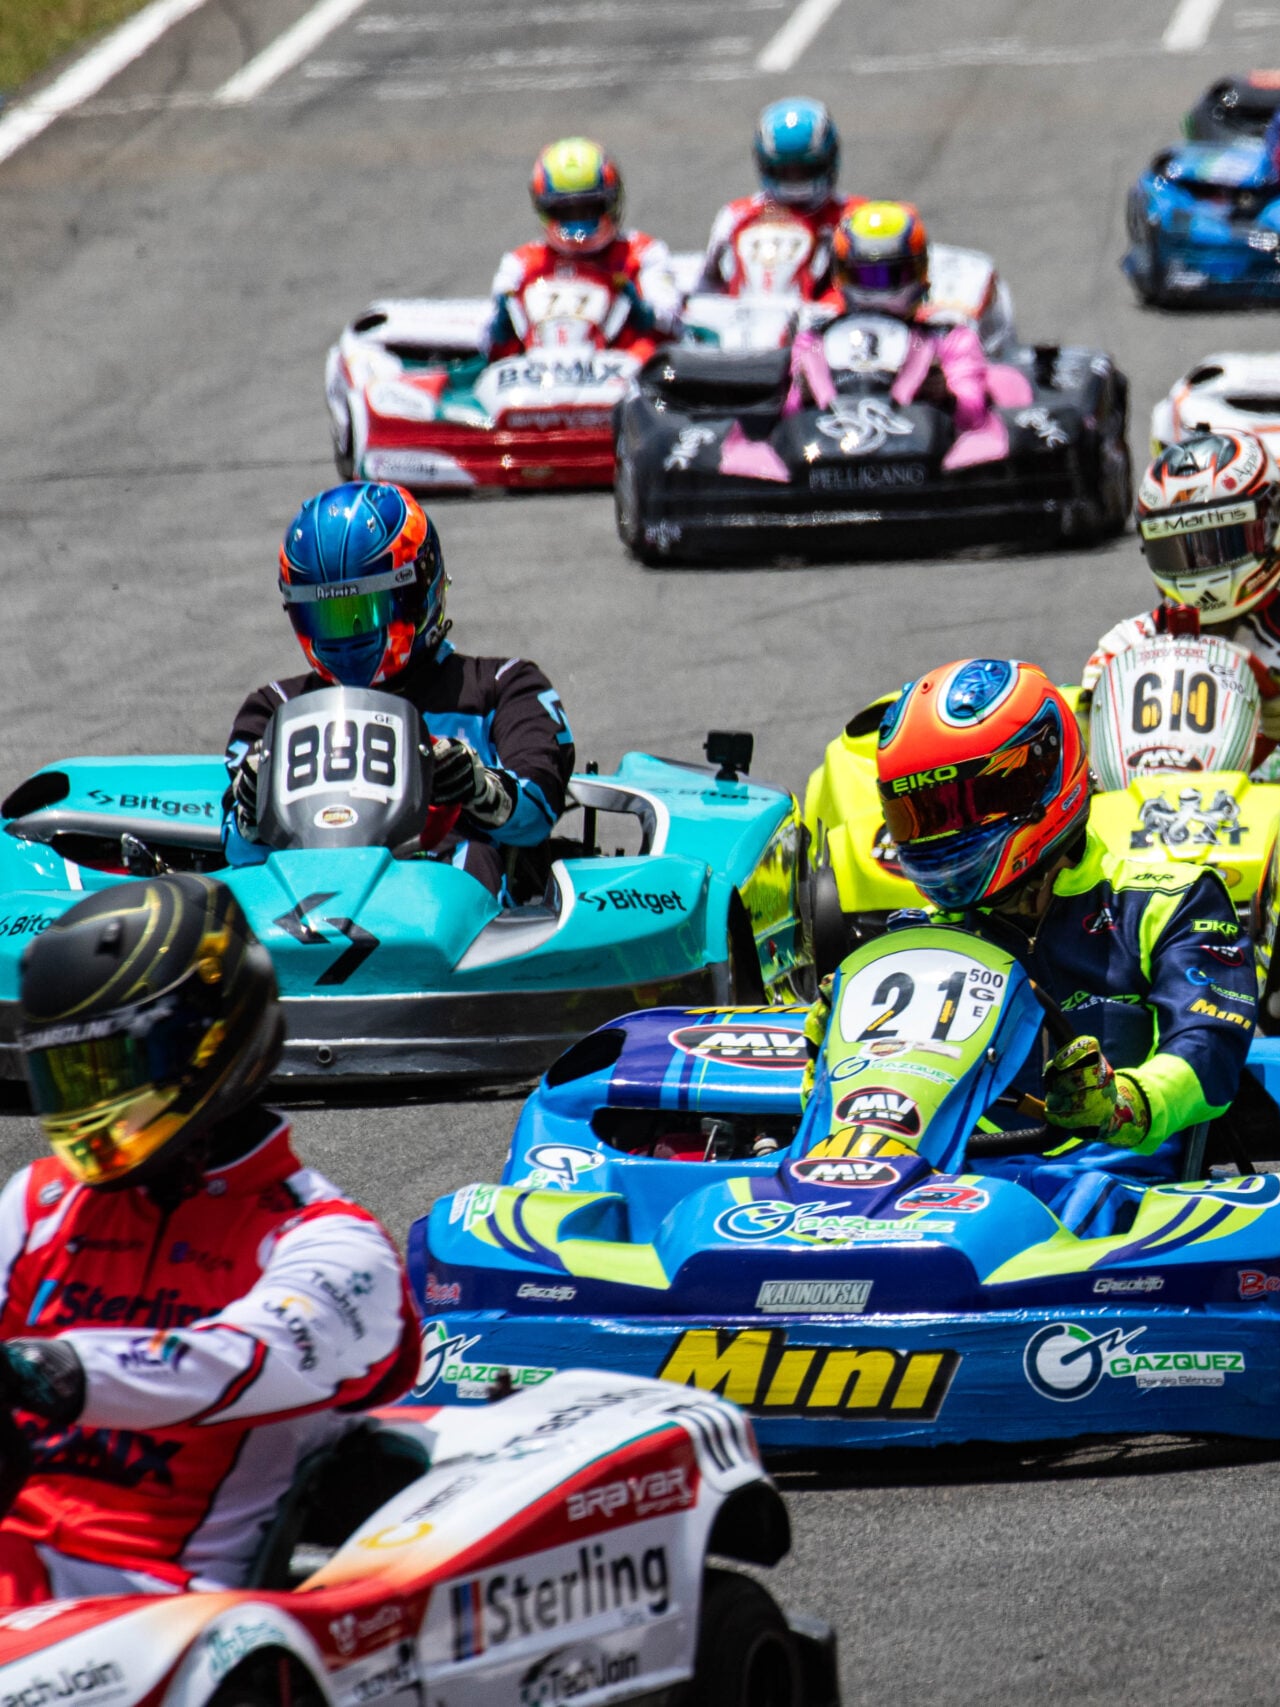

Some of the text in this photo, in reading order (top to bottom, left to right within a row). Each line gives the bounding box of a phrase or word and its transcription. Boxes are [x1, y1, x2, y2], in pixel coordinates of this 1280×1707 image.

[1165, 508, 1247, 530] Martins
[1132, 669, 1218, 735] 610
[374, 714, 394, 724] GE
[287, 719, 396, 792] 888
[892, 765, 958, 794] EIKO
[119, 794, 215, 818] Bitget
[605, 888, 687, 914] Bitget
[968, 967, 1004, 989] 500
[969, 986, 995, 1002] G
[856, 970, 968, 1042] 21
[972, 1005, 984, 1018] E
[870, 1062, 958, 1085] GAZQUEZ
[845, 1093, 918, 1123] MV
[800, 1162, 888, 1182] MV
[799, 1217, 952, 1231] GAZQUEZ
[760, 1282, 871, 1305] KALINOWSKI
[55, 1281, 224, 1330] Sterlin
[1109, 1353, 1245, 1376] GAZQUEZ
[483, 1544, 671, 1642] Sterling
